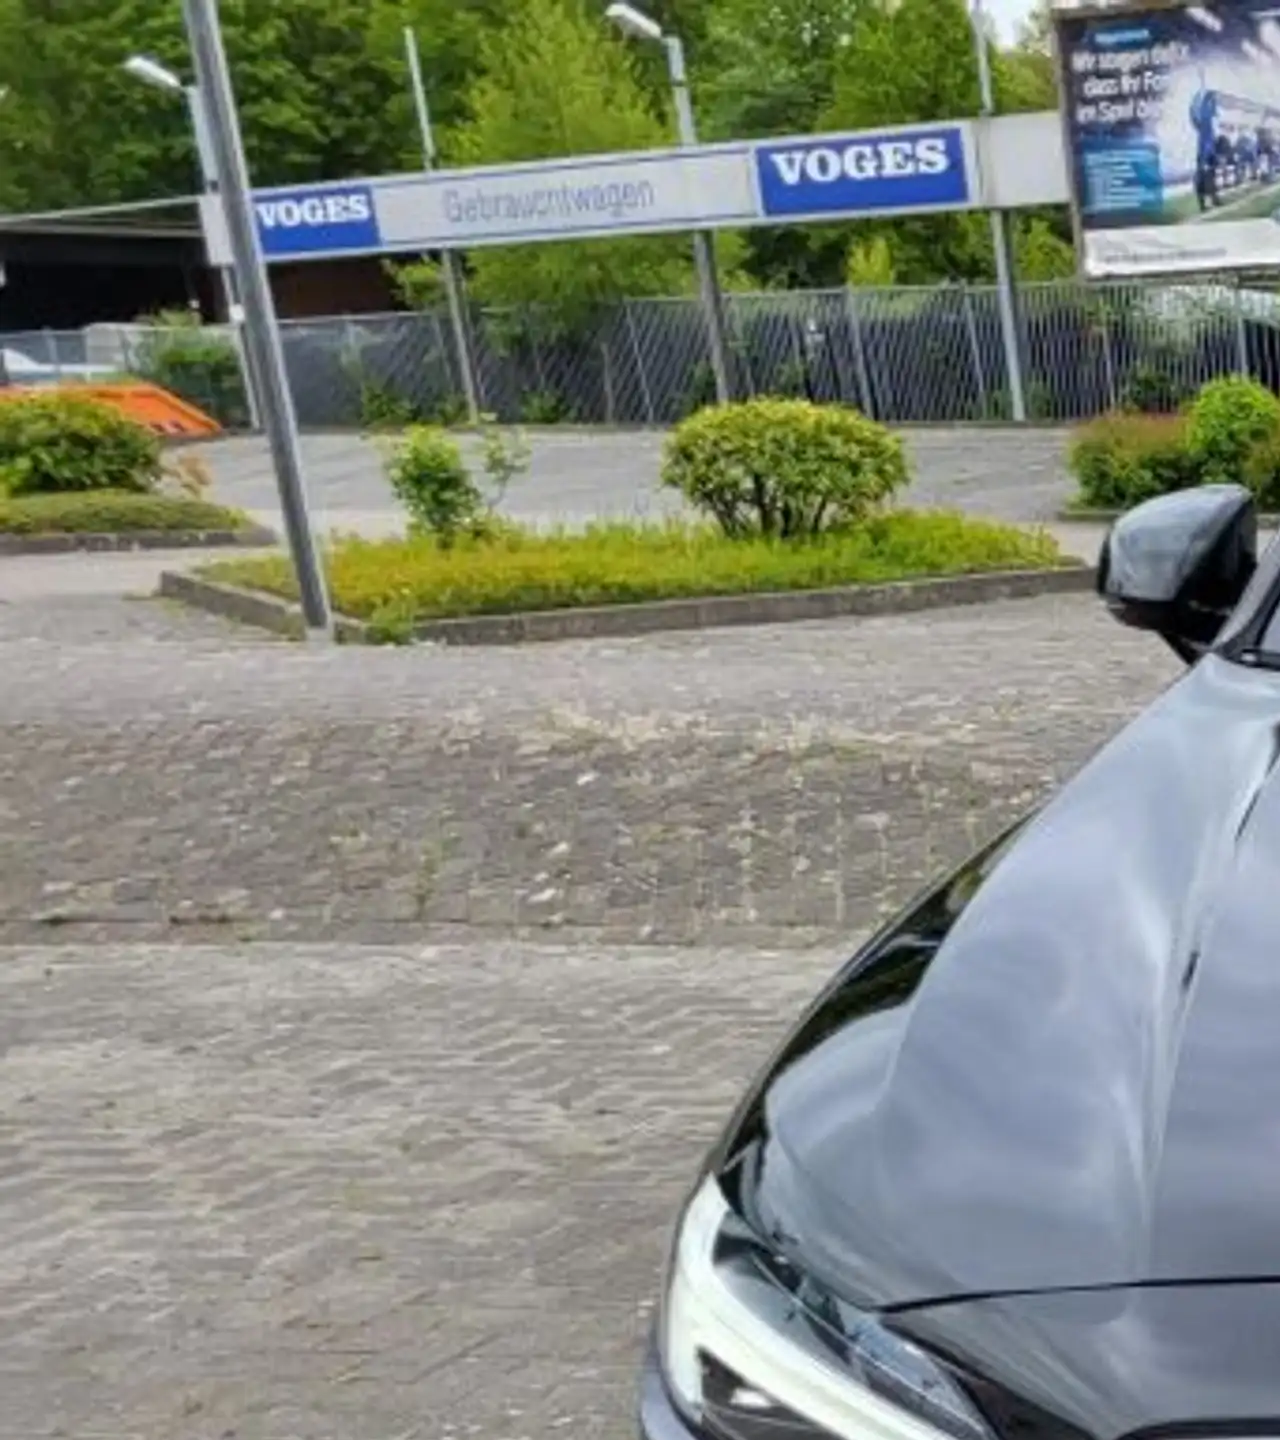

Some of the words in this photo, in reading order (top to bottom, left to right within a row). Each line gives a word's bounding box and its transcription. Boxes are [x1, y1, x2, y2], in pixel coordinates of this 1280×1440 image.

[769, 138, 949, 186] VOGES
[256, 193, 371, 228] VOGES
[442, 179, 655, 224] Gebrauchtwagen
